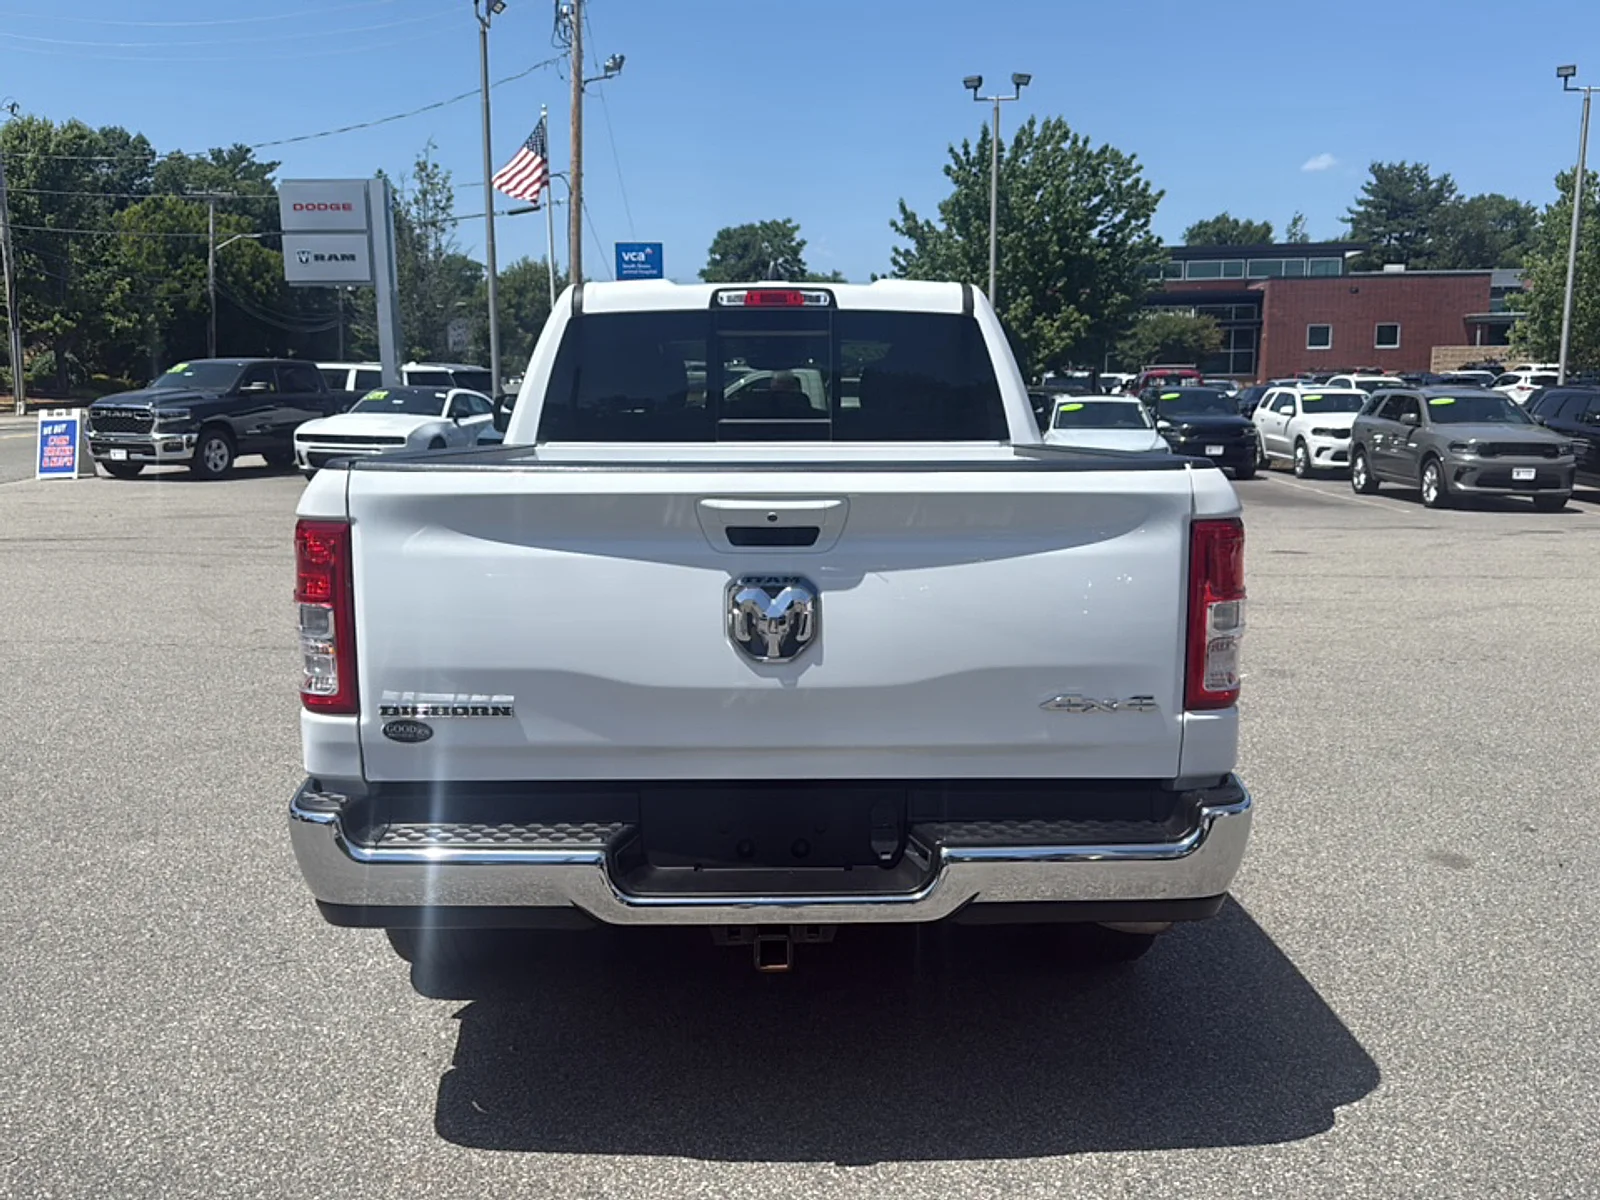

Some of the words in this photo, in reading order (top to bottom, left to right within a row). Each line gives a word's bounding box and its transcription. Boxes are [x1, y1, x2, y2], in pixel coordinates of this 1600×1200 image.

[293, 203, 352, 211] DODGE
[313, 253, 356, 261] RAM
[621, 251, 646, 262] vca
